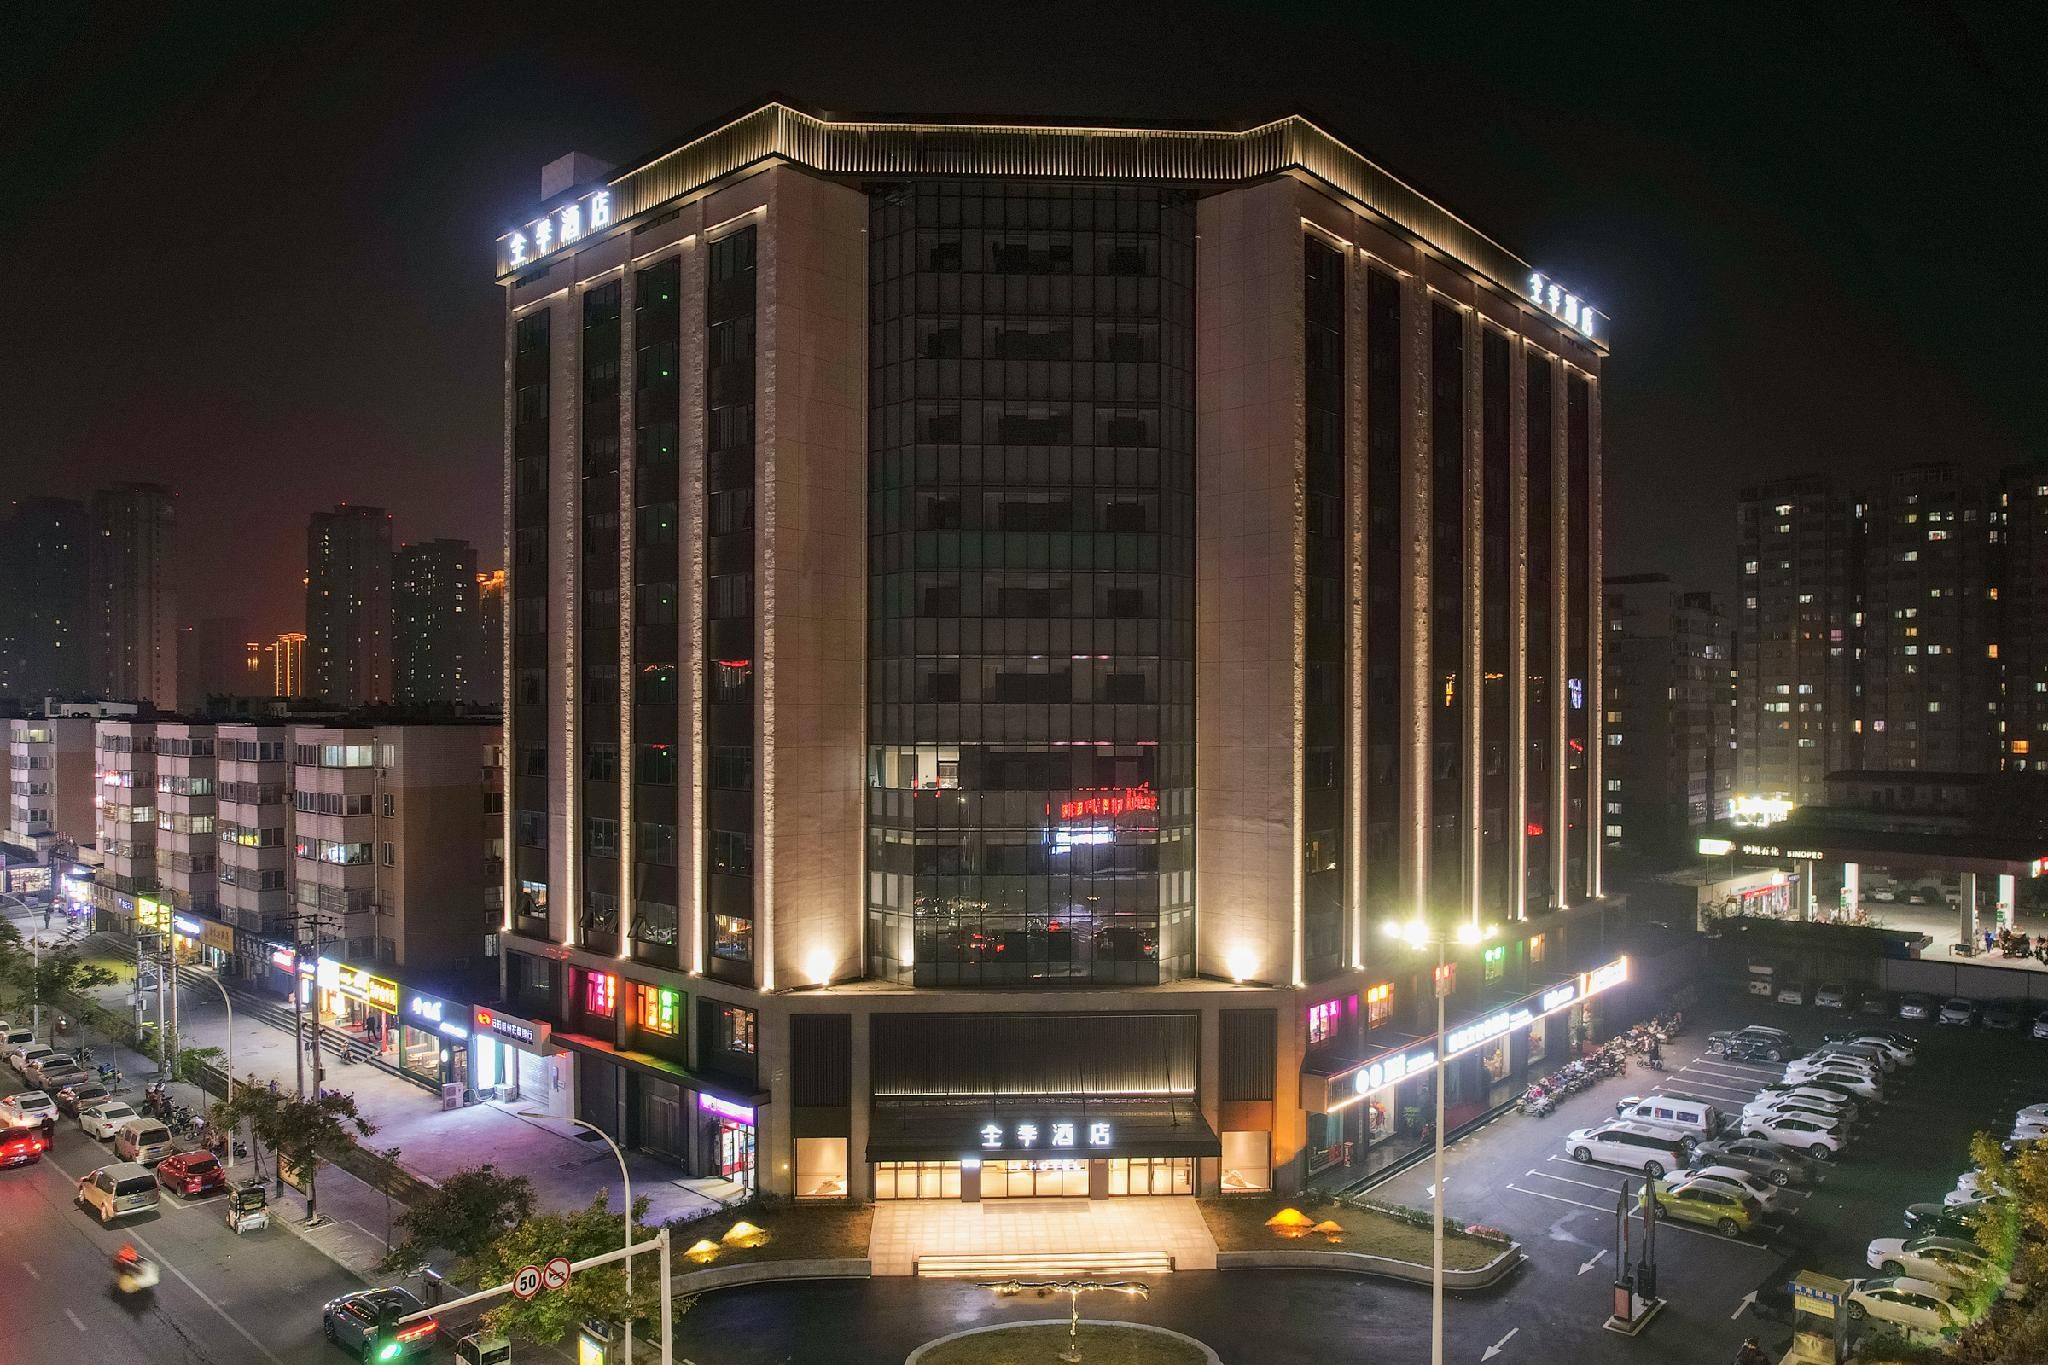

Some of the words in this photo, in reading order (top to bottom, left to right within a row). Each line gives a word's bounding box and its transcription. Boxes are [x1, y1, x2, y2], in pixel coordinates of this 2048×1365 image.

[1742, 844, 1780, 857] 中国石化
[1787, 850, 1824, 860] SINOPEC
[980, 1122, 1111, 1147] 全季酒店
[520, 1274, 537, 1292] 50
